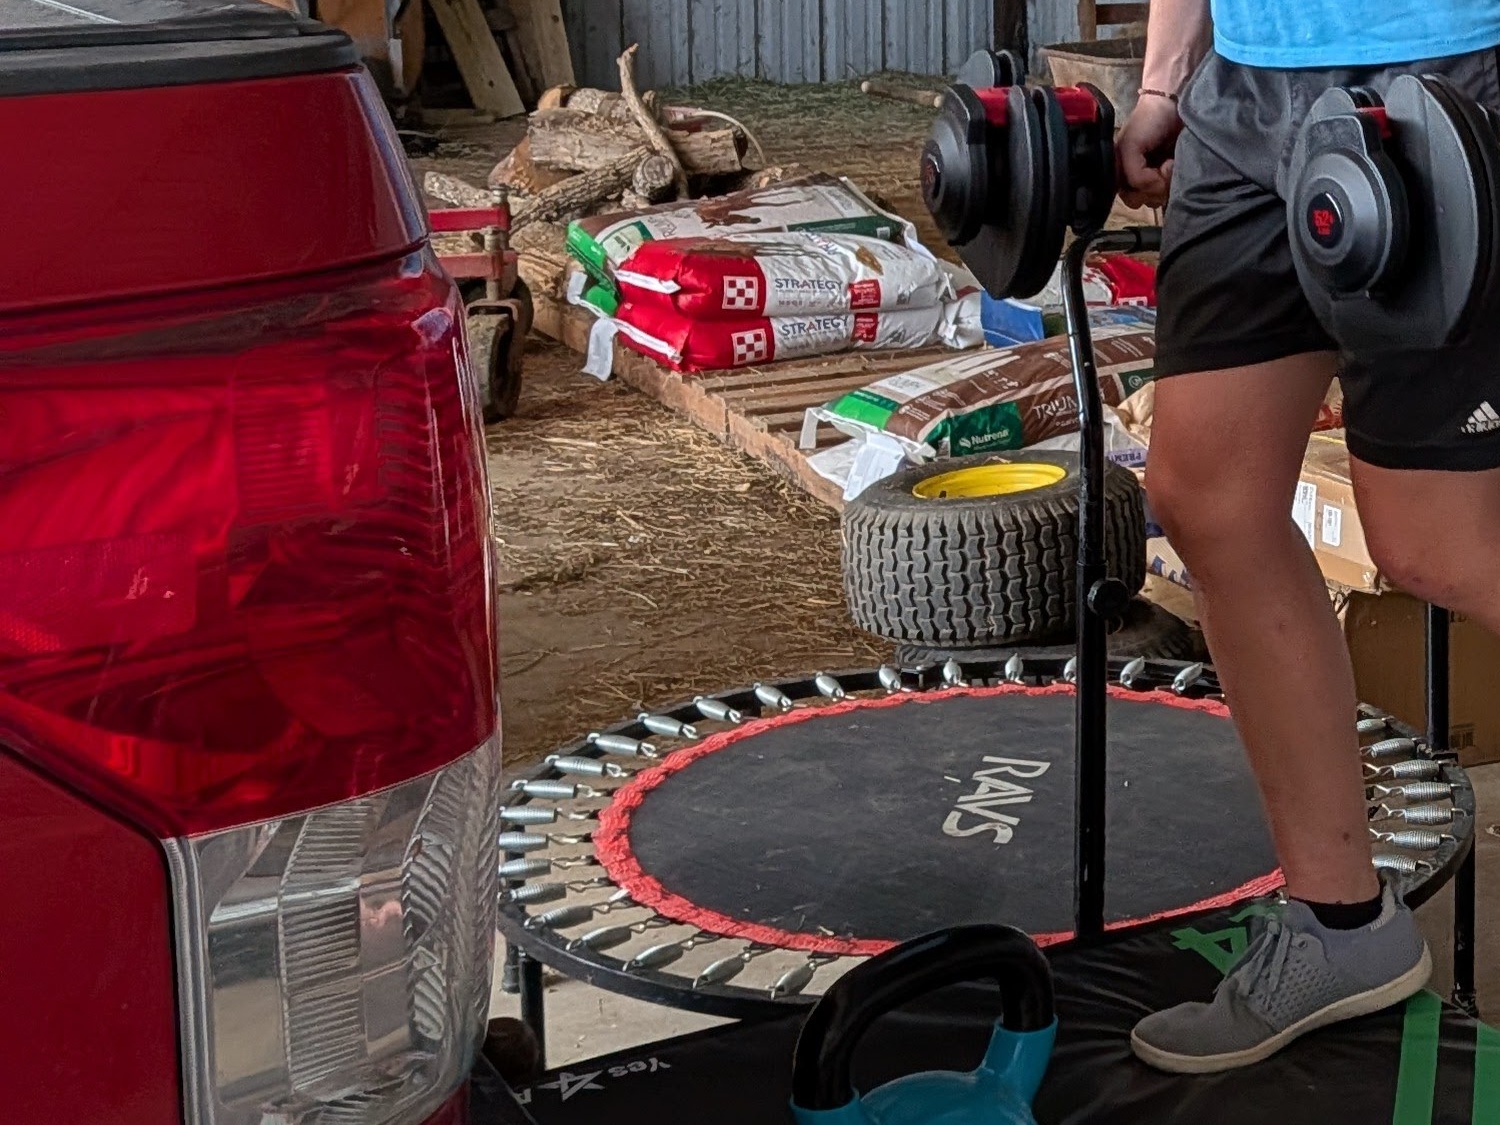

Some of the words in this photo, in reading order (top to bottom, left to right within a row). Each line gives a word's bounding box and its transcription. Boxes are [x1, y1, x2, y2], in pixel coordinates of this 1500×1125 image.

[774, 277, 843, 291] STRATEGY
[781, 315, 848, 337] STRATEGY
[970, 428, 1010, 445] Nutrena
